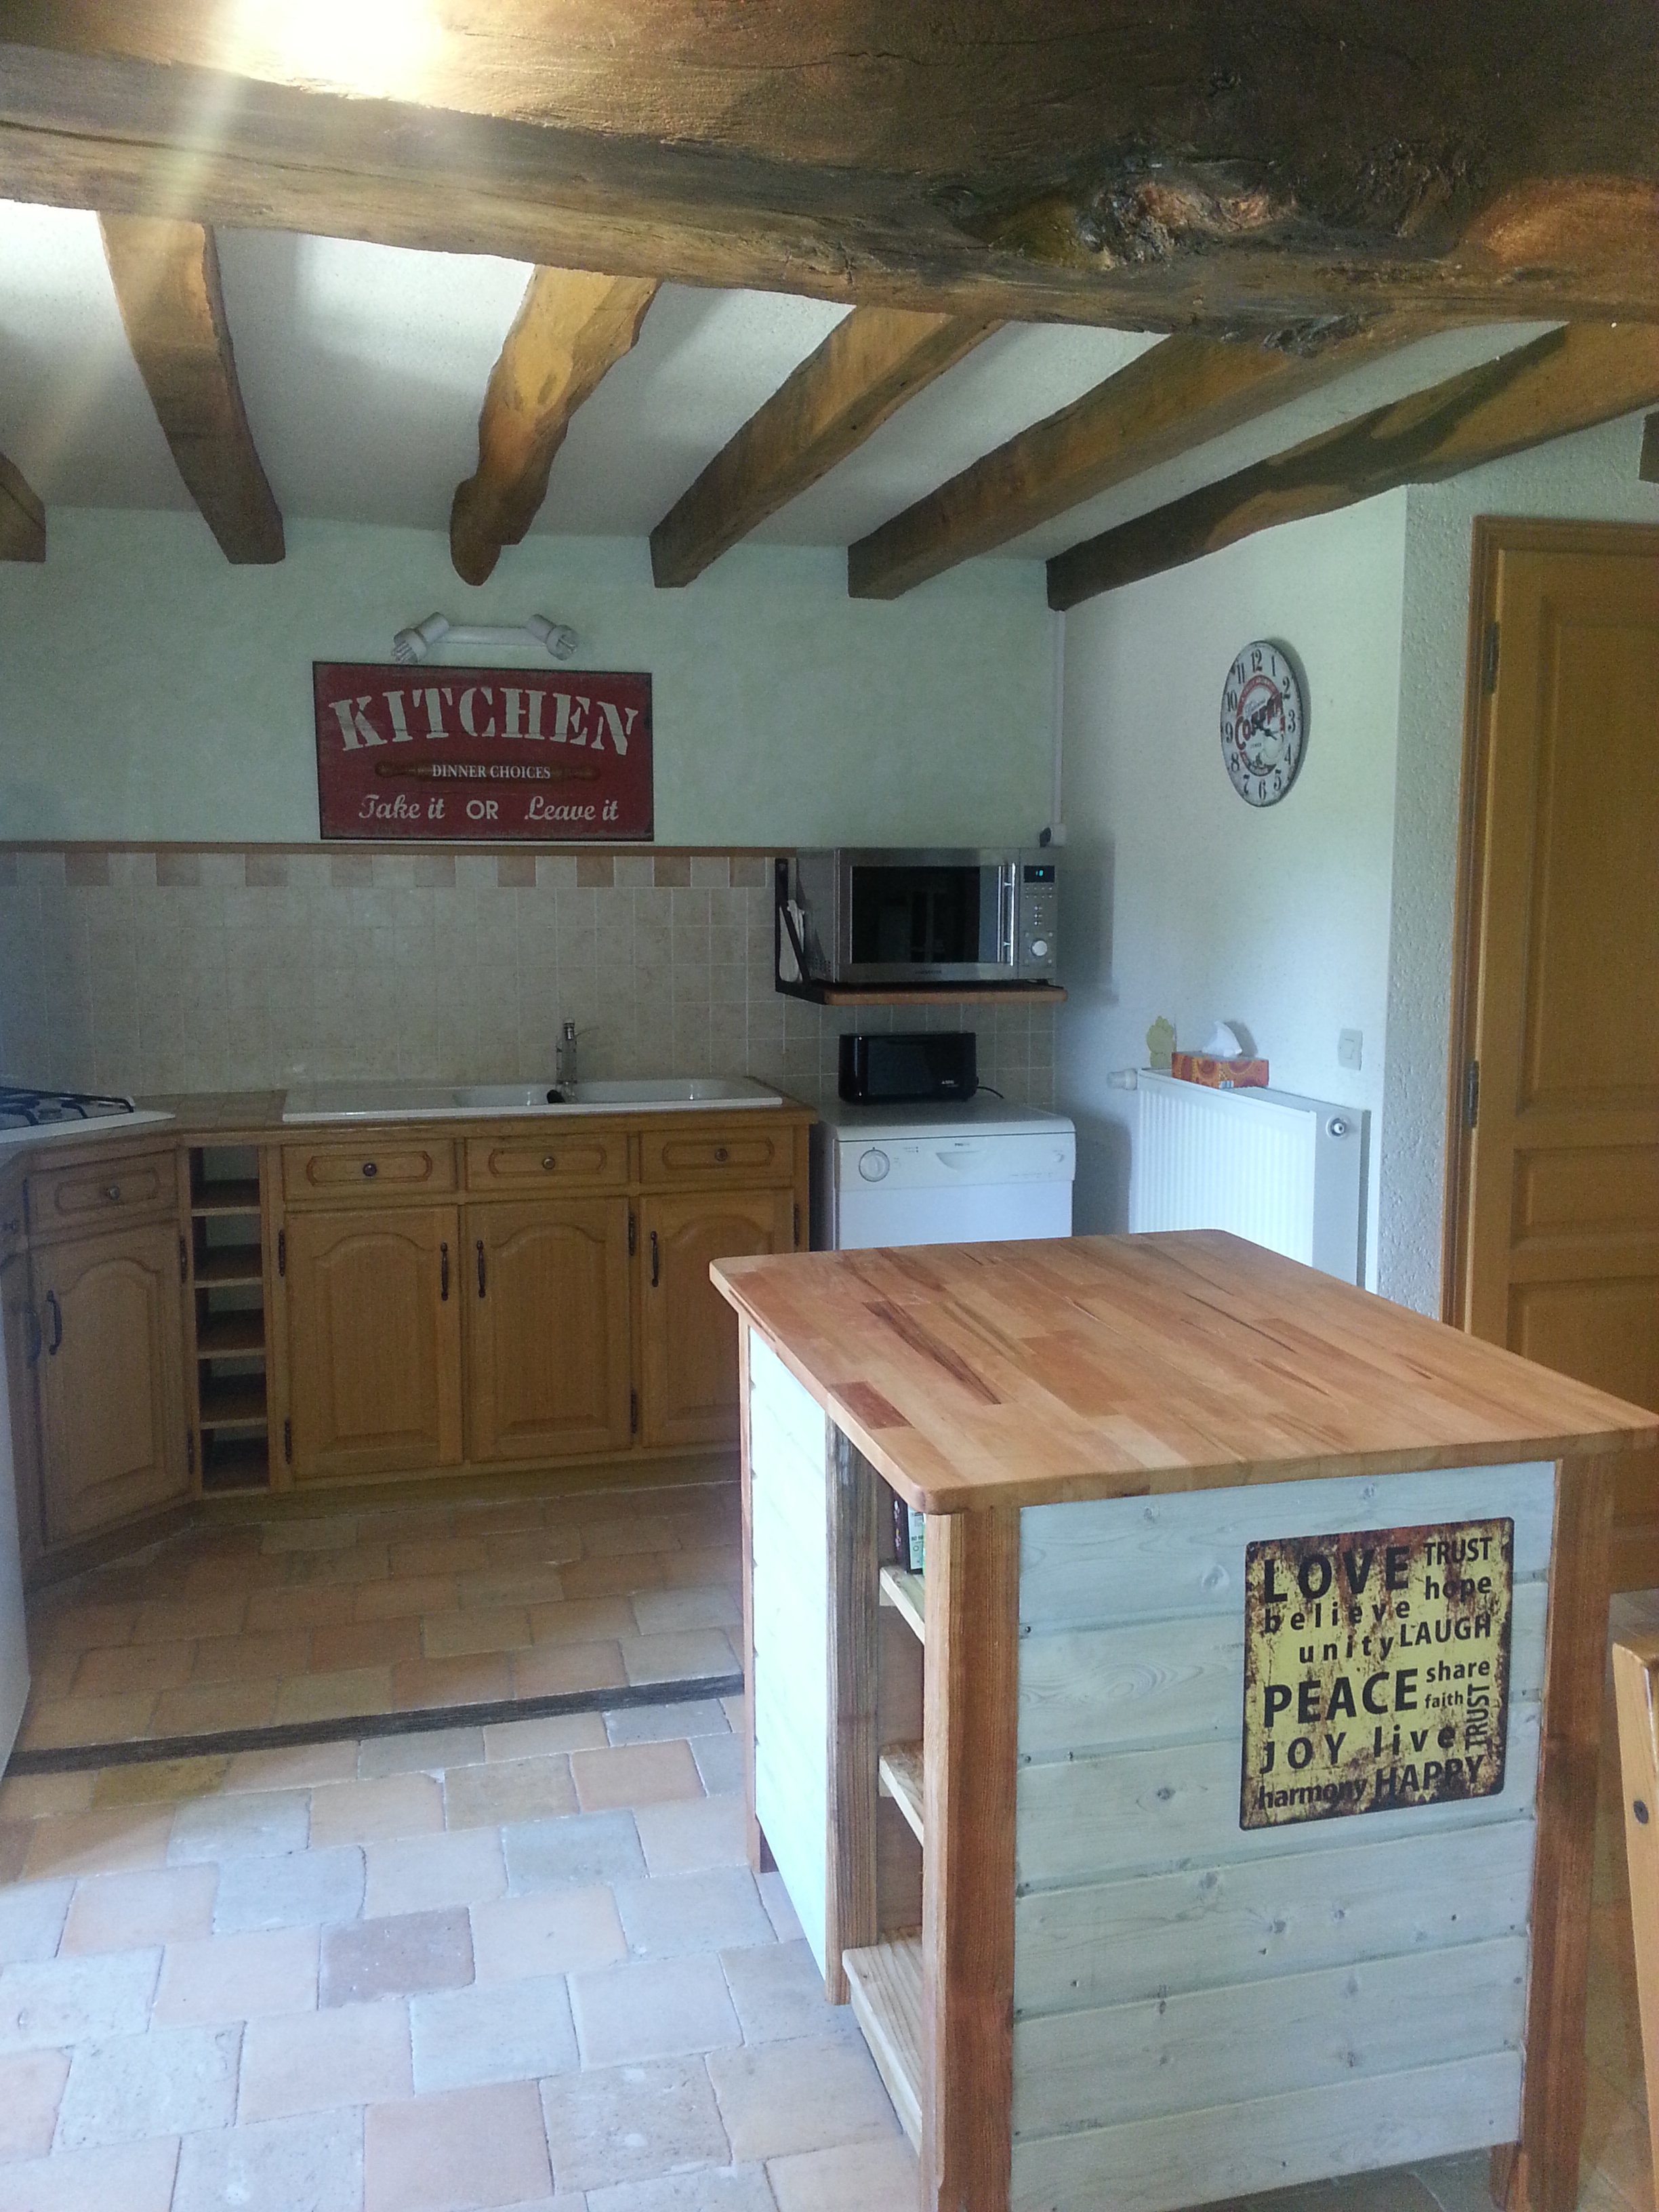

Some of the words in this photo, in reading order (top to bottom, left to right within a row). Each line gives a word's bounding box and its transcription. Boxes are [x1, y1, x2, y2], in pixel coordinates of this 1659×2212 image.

[1237, 662, 1245, 684] 11
[1251, 649, 1263, 673] 12
[1271, 655, 1276, 676] 1
[1283, 676, 1291, 699] 2
[1227, 690, 1237, 712] 10
[329, 687, 638, 756] KITCHEN
[1225, 722, 1233, 743] 9
[1288, 710, 1296, 733] 3
[1231, 752, 1240, 773] 8
[1284, 743, 1291, 765] 4
[432, 764, 487, 779] DINNER
[490, 765, 551, 779] CHOICES
[1273, 769, 1282, 792] 5
[1243, 774, 1250, 795] 7
[1258, 779, 1267, 800] 6
[359, 794, 421, 820] Take
[428, 796, 445, 820] it
[466, 800, 498, 819] OR
[524, 796, 596, 821] Leave
[601, 799, 619, 821] it
[1423, 1536, 1492, 1566] TRUST
[1263, 1545, 1410, 1604] LOVE
[1425, 1575, 1492, 1603] hope
[1264, 1599, 1410, 1634] believe
[1400, 1614, 1491, 1647] LAUGH
[1298, 1635, 1394, 1664] unity
[1426, 1660, 1490, 1683] share
[1263, 1668, 1418, 1728] PEACE
[1425, 1690, 1464, 1709] faith
[1466, 1683, 1490, 1750] TRUST
[1260, 1732, 1347, 1774] JOY
[1373, 1725, 1456, 1758] live
[1374, 1754, 1486, 1799] HAPPY
[1258, 1777, 1368, 1810] harmony
